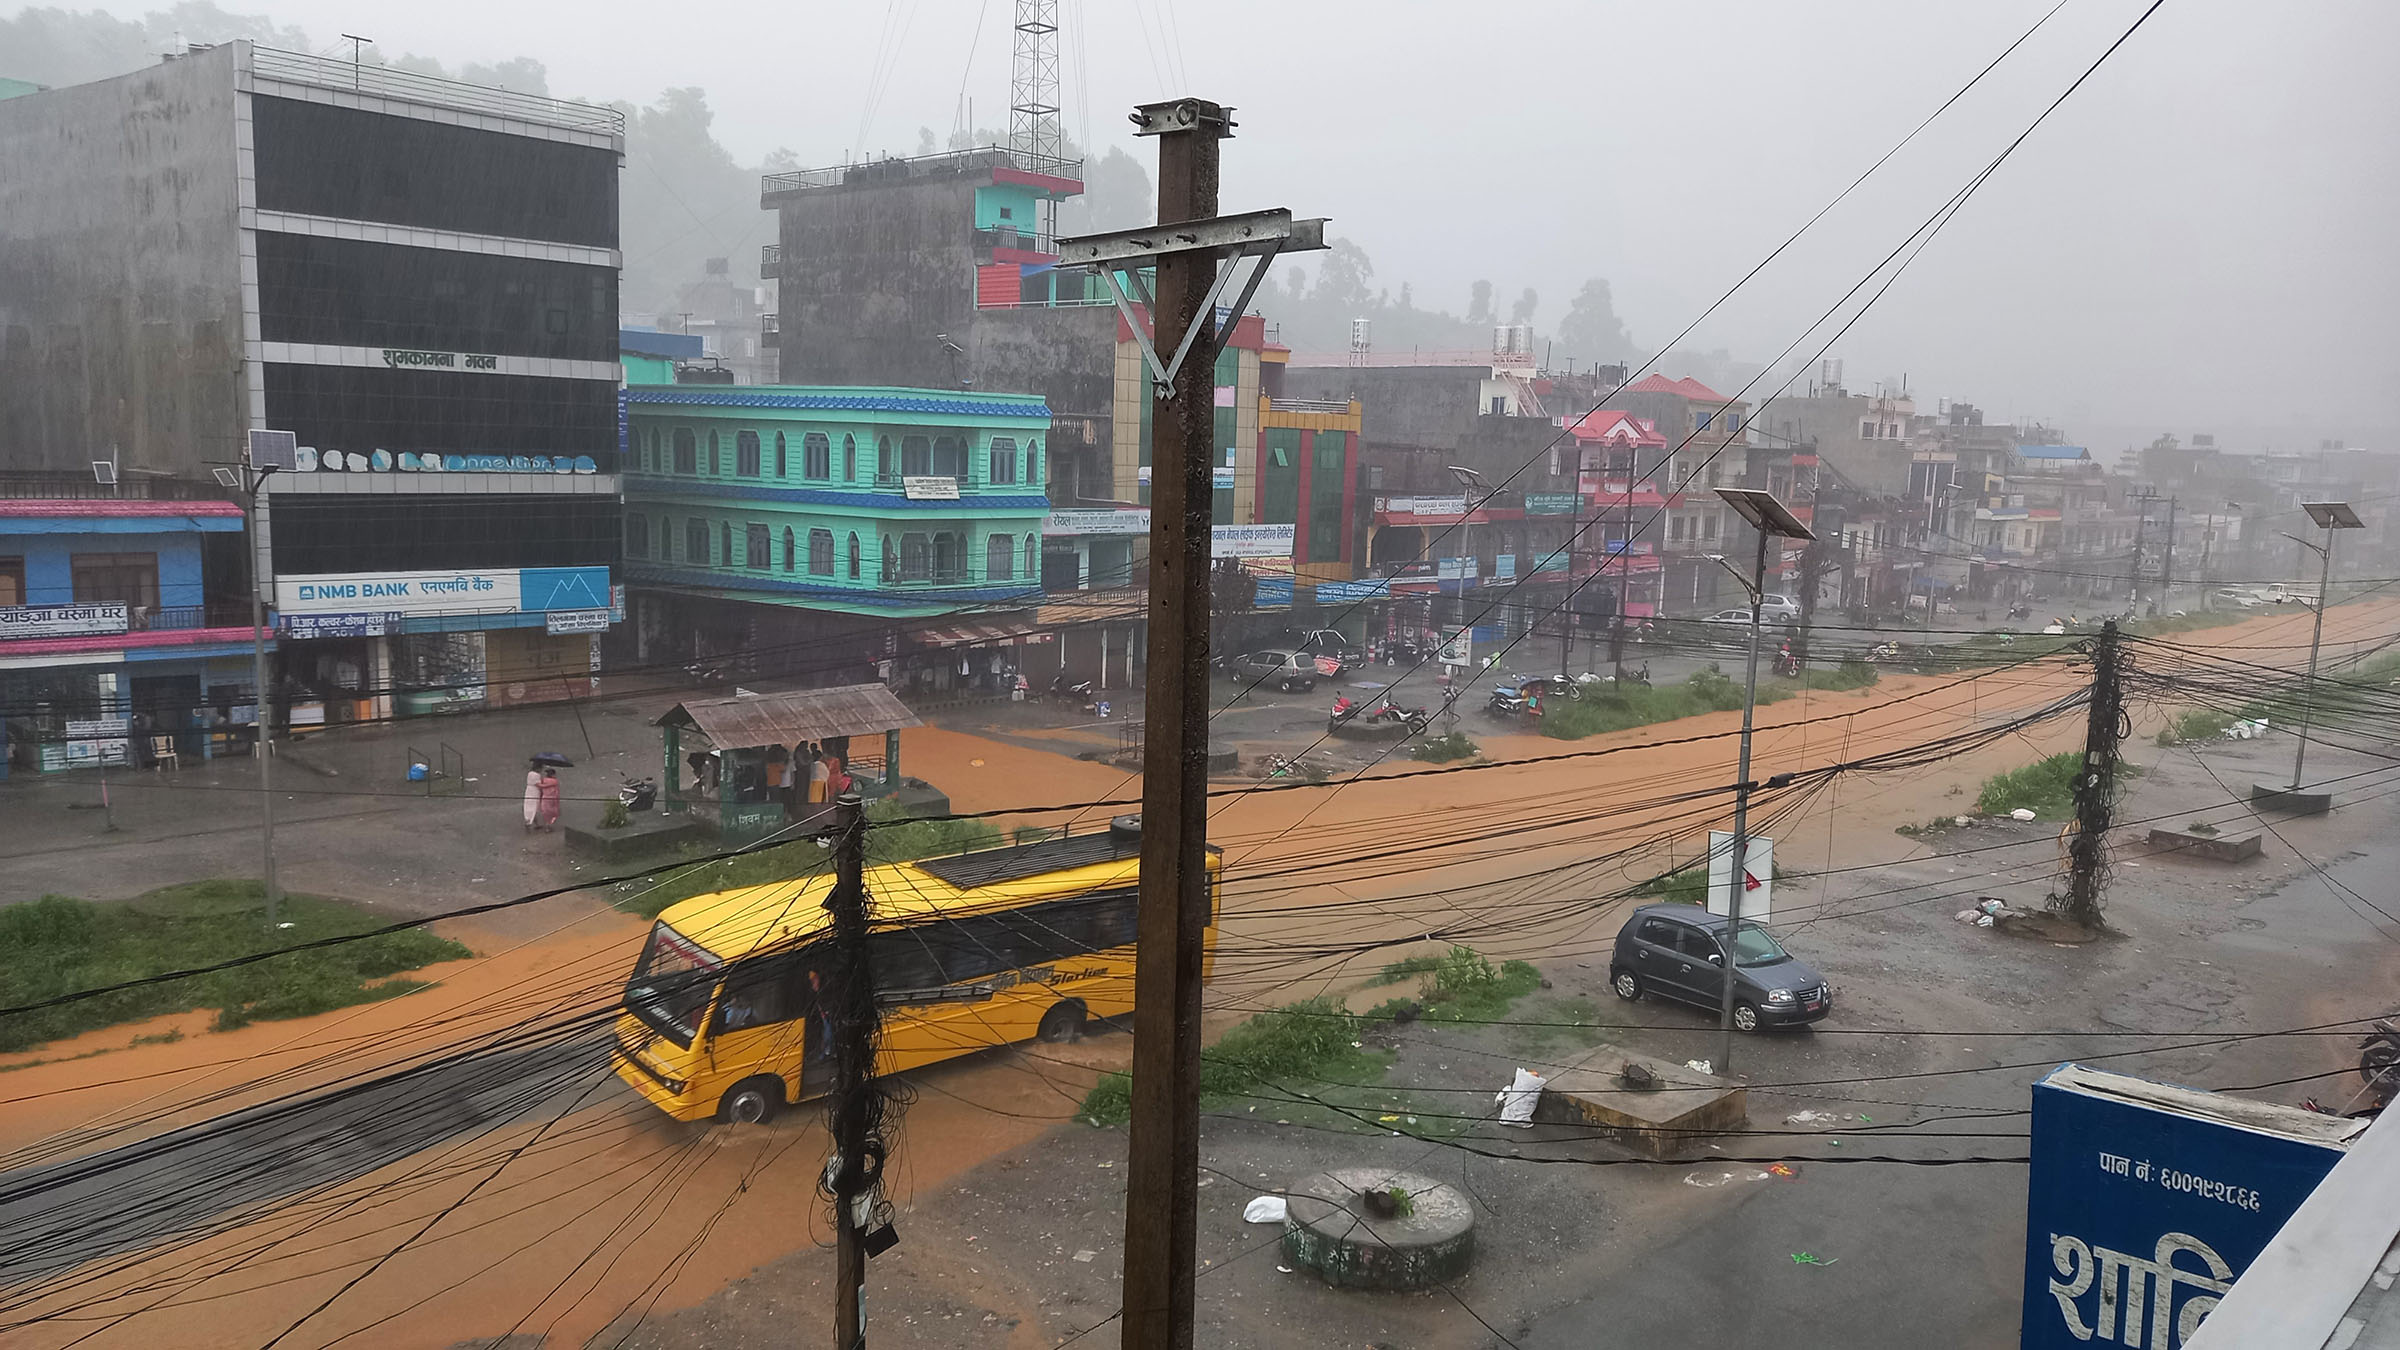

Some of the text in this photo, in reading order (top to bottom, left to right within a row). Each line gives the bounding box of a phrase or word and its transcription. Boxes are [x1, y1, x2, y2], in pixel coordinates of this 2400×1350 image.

[464, 355, 498, 370] भवन
[318, 582, 409, 599] NMB BANK
[101, 607, 124, 618] घर
[2099, 1152, 2131, 1177] पान
